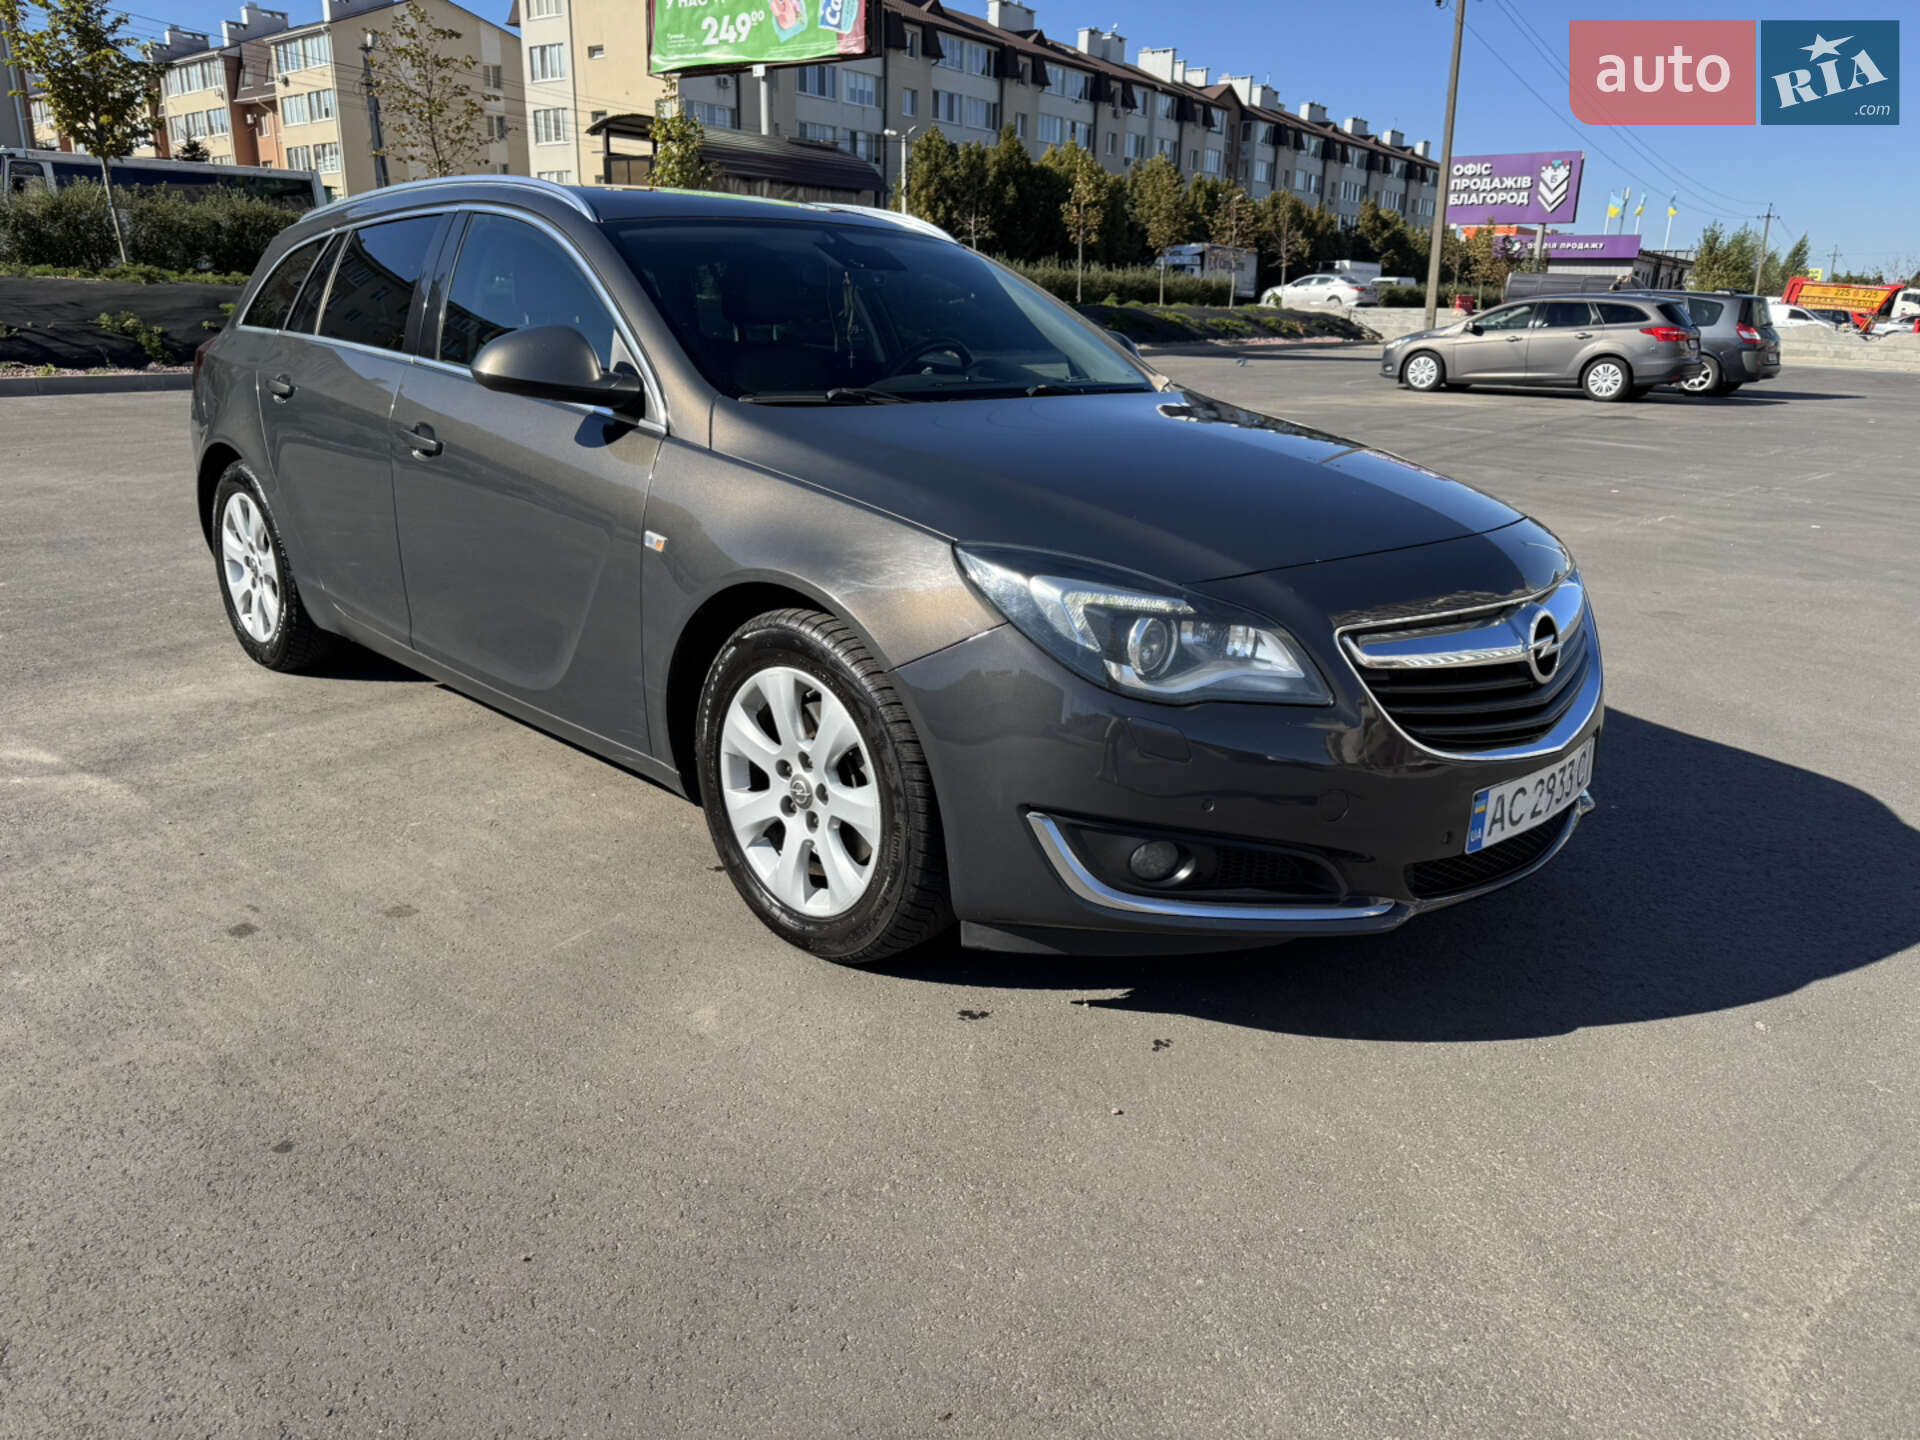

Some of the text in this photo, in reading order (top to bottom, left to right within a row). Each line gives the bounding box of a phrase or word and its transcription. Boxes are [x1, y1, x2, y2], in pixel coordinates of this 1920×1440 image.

[1453, 163, 1492, 176] ОФІС
[1450, 176, 1532, 191] ПРОДАЖІВ
[1449, 191, 1529, 206] БЛАГОРОД
[1559, 241, 1604, 250] ПРОДАЖУ
[1487, 786, 1527, 837] AC
[1530, 758, 1575, 820] 2933
